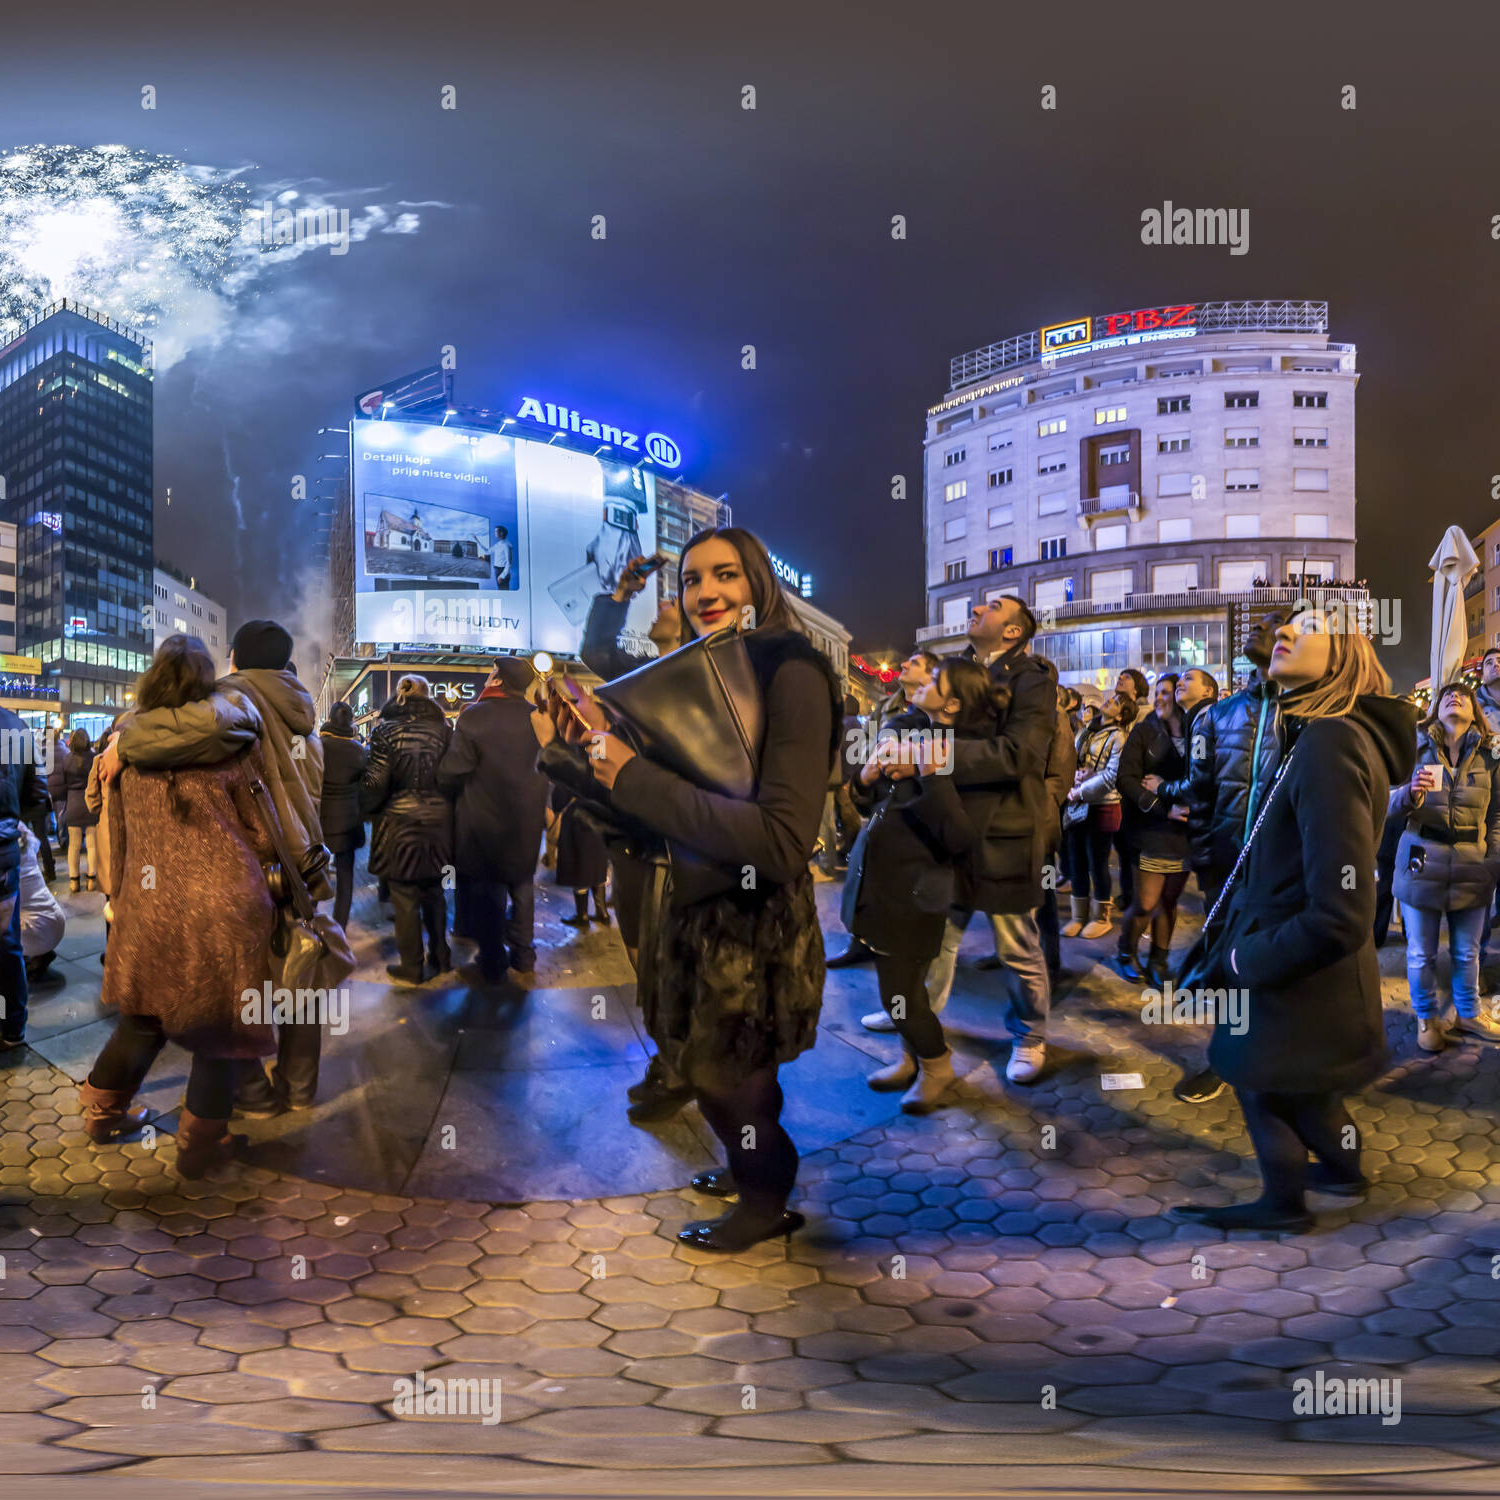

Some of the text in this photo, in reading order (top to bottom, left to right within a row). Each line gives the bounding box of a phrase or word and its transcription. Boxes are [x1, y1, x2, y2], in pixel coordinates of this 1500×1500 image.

[1104, 304, 1197, 336] PBZ
[516, 396, 640, 452] Allianz
[363, 452, 431, 467] Detalji koje
[392, 466, 492, 485] prije niste vidjeli.
